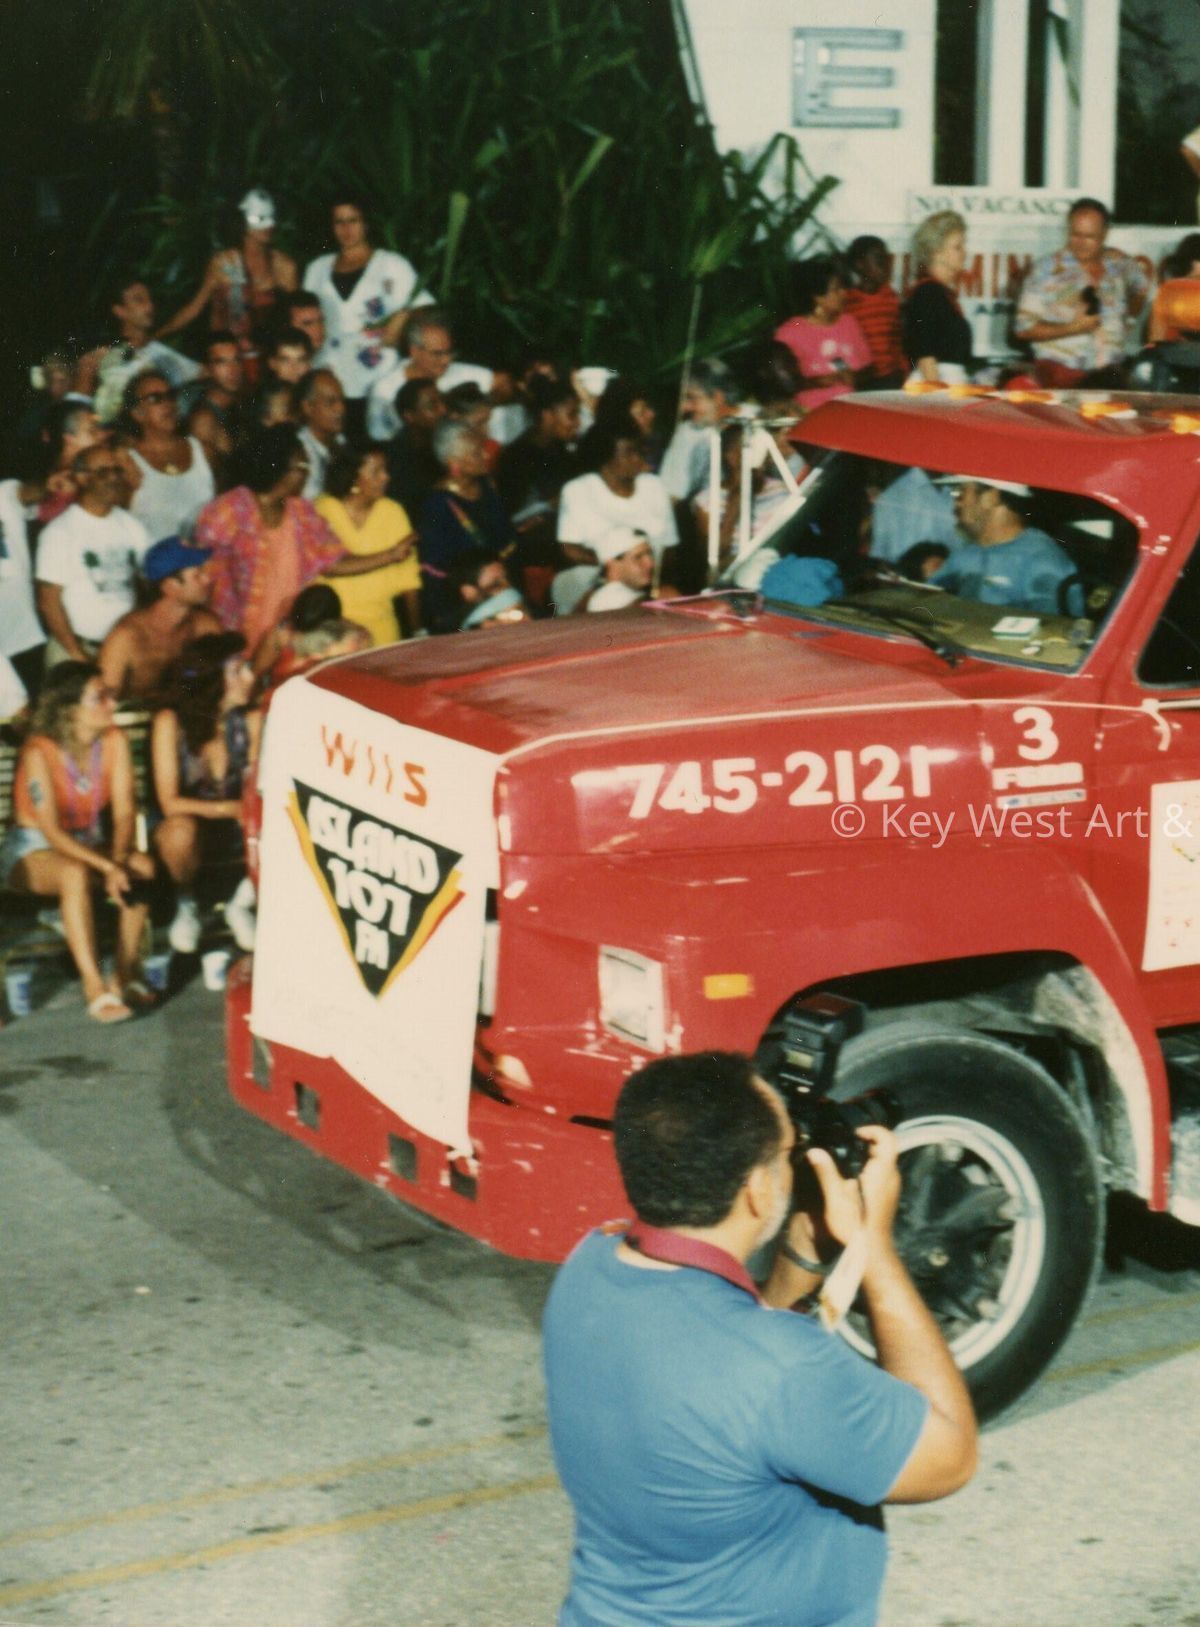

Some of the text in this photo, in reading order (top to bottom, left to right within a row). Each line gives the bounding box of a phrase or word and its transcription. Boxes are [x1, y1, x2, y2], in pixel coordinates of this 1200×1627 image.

[792, 26, 905, 128] E
[962, 196, 1073, 215] VACANC
[1012, 705, 1060, 761] 3
[620, 743, 934, 820] 745-2121
[306, 795, 440, 890] ISLAND
[327, 857, 413, 937] 107
